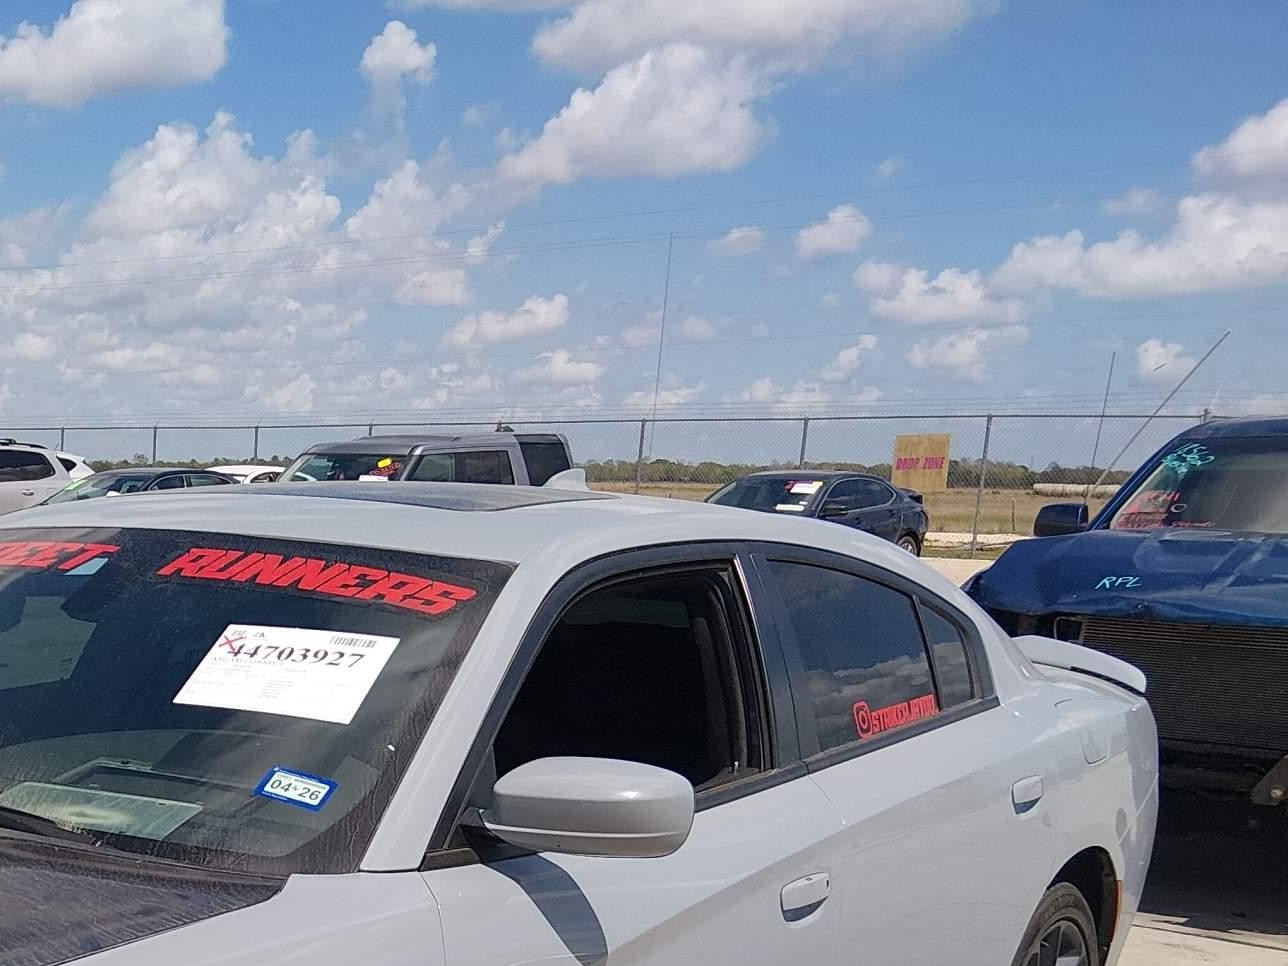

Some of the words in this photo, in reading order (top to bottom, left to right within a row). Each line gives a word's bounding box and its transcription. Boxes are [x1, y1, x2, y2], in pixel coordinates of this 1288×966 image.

[895, 457, 920, 471] DROP
[922, 456, 946, 470] ZONE
[157, 547, 477, 616] RUNNERS
[1094, 576, 1142, 590] RPL
[226, 643, 366, 669] 44703927
[270, 779, 293, 793] 04
[297, 787, 322, 801] 26
